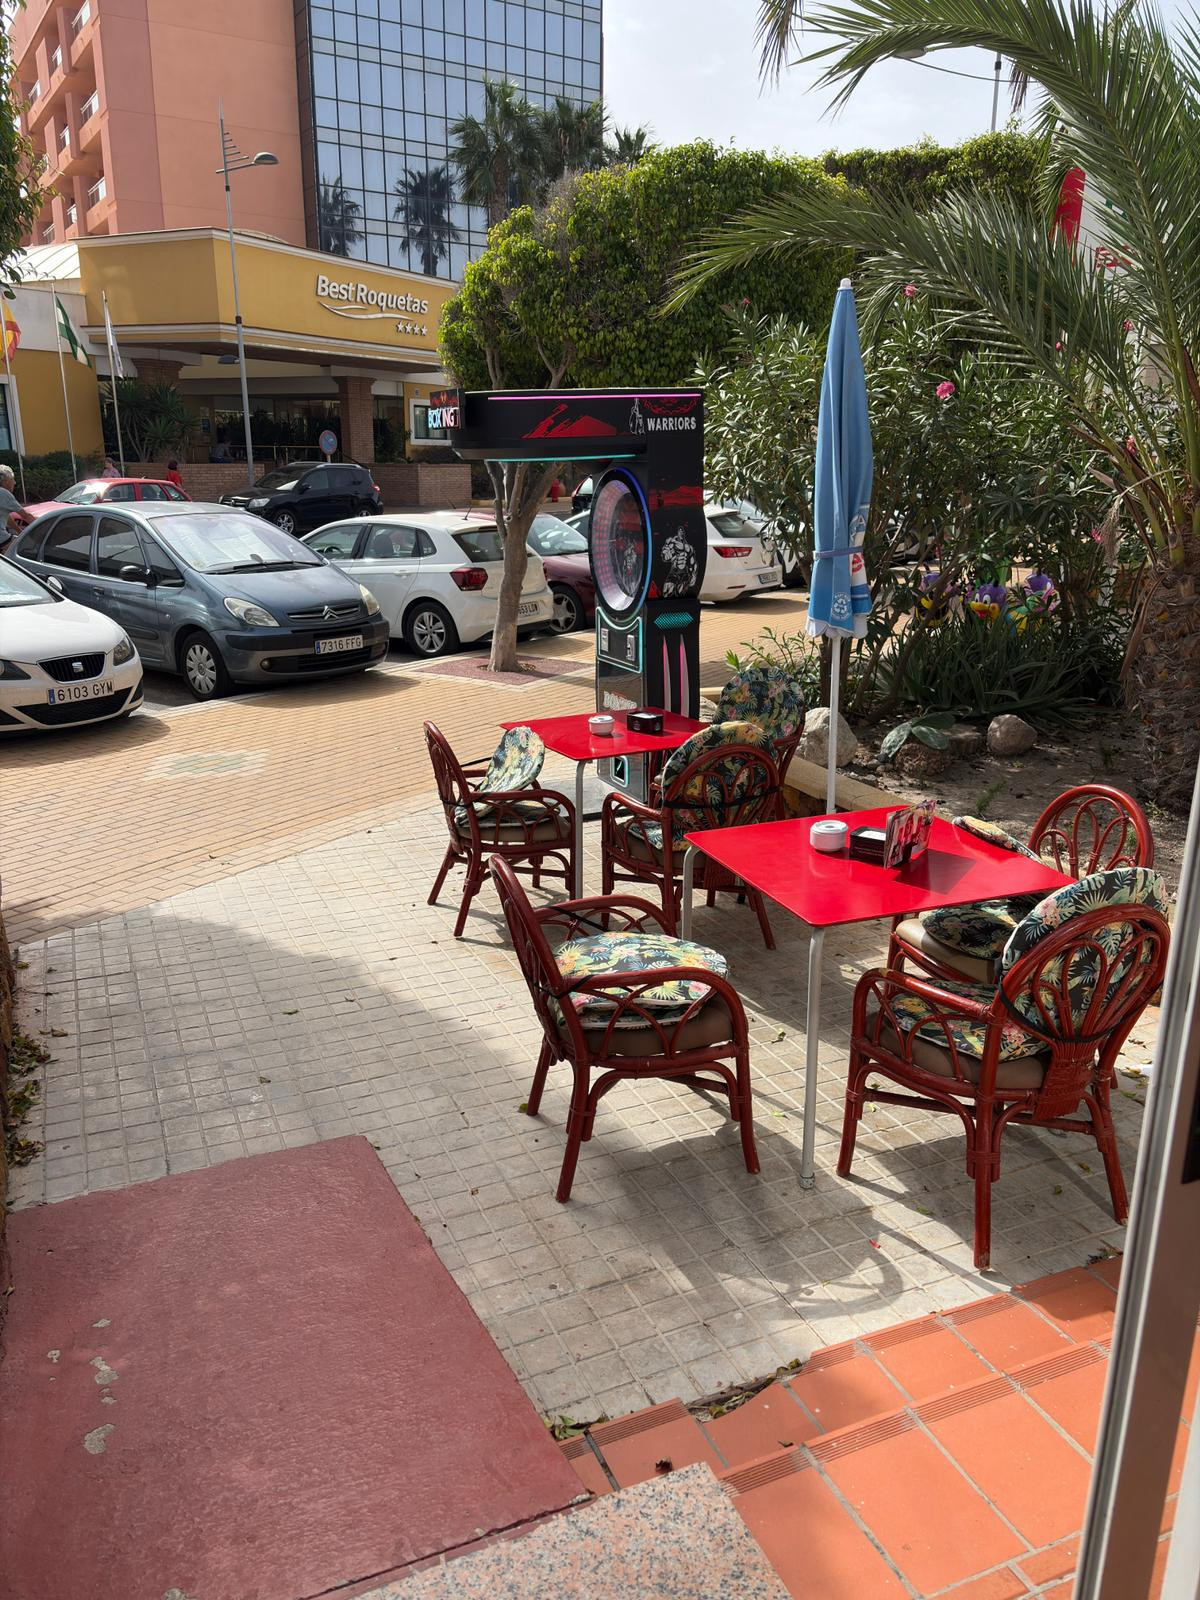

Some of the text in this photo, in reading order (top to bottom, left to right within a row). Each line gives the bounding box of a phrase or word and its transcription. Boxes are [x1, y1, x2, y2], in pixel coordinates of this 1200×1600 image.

[317, 275, 428, 314] Best Roquetas
[647, 416, 697, 431] WARRIORS
[321, 637, 361, 653] 7316 FFG
[57, 680, 114, 702] 6103 GYM
